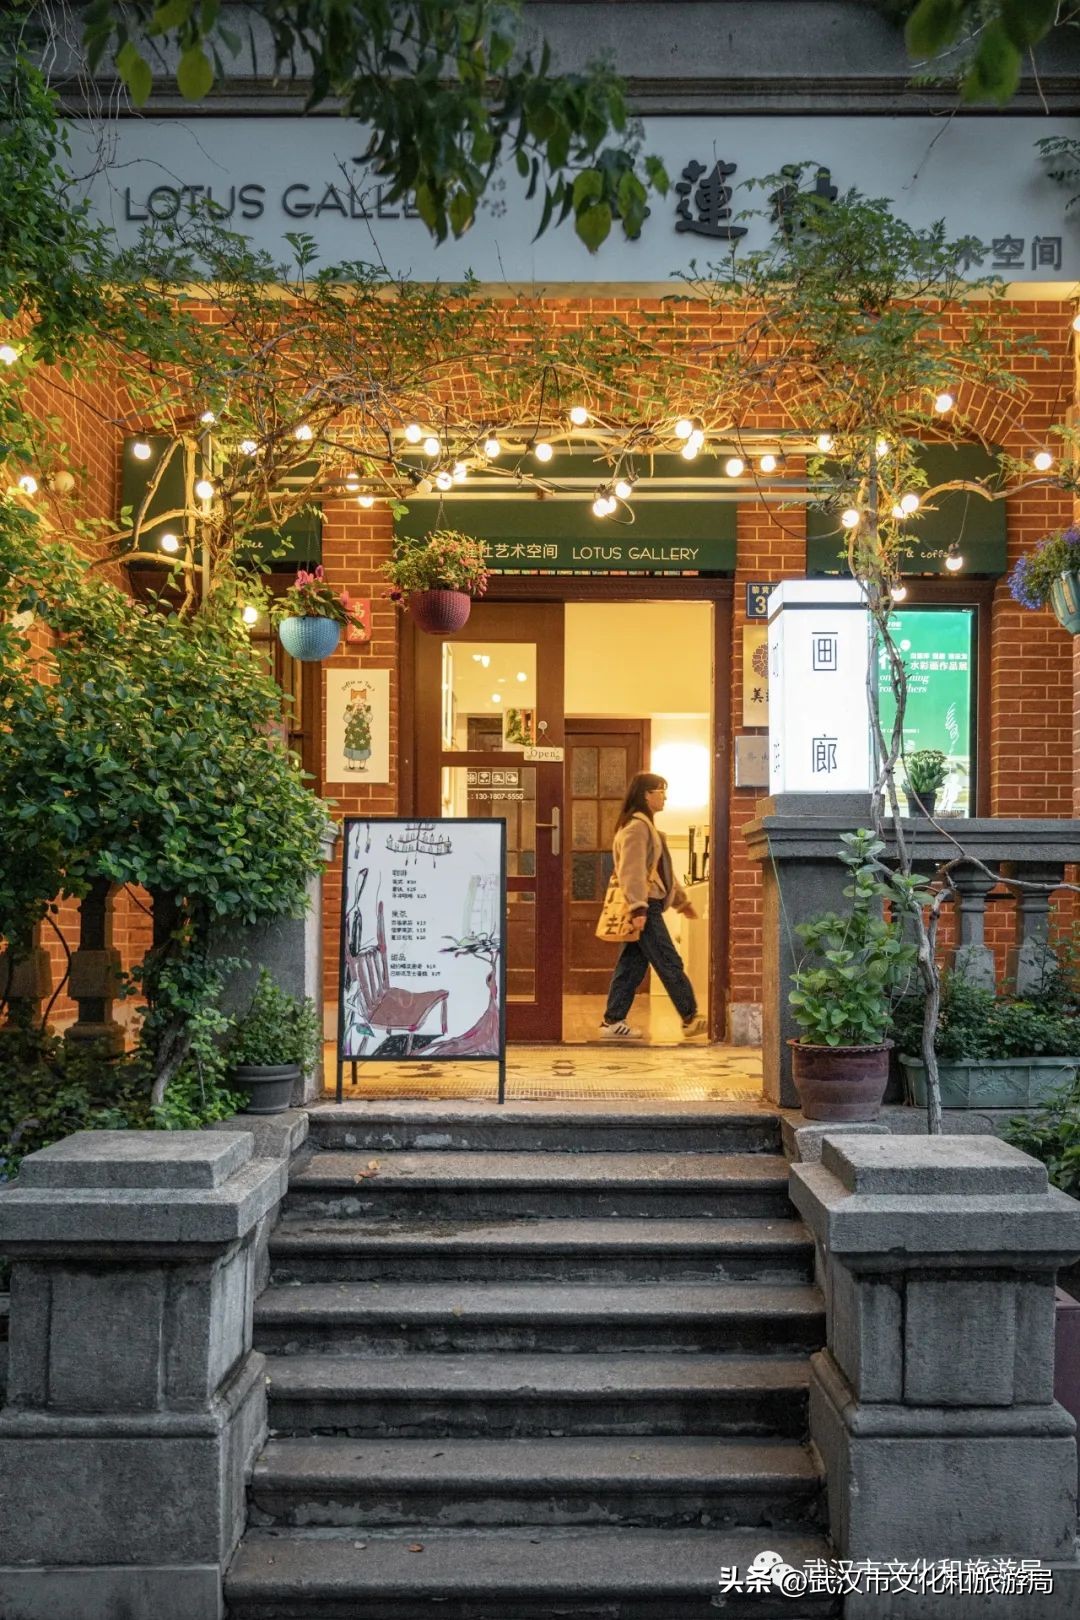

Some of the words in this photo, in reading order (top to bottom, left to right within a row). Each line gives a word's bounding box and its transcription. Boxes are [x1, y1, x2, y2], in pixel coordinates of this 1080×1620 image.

[125, 183, 266, 221] LOTUS
[281, 183, 428, 219] GALLE
[930, 233, 1062, 271] 术空间
[572, 546, 622, 560] LOTUS
[628, 546, 700, 561] GALLERY
[750, 687, 769, 703] 美
[811, 632, 839, 774] 画廊
[530, 749, 556, 759] Open
